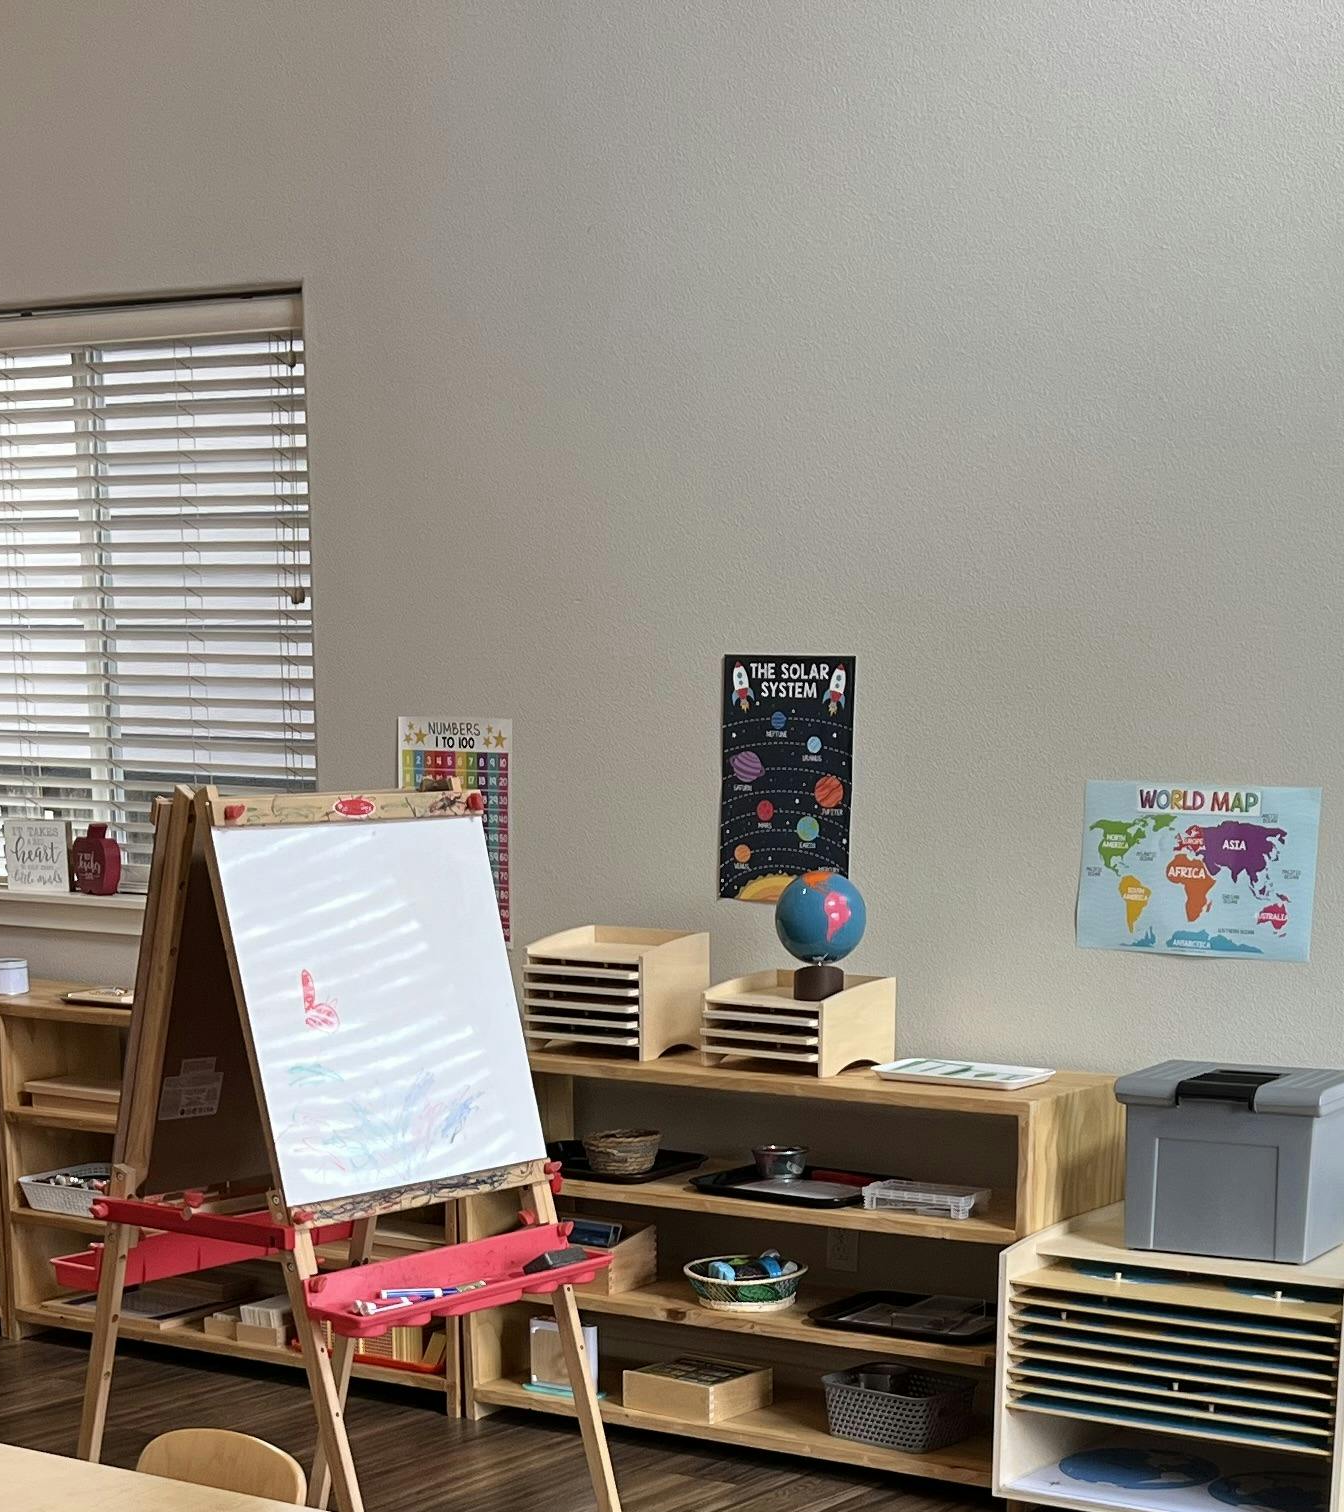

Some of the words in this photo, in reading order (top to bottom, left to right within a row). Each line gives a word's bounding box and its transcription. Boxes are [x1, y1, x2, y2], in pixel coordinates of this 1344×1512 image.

[750, 663, 776, 679] THE
[781, 663, 830, 680] SOLAR
[761, 681, 817, 698] SYSTEM
[428, 721, 481, 737] NUMBERS
[435, 735, 439, 748] 1
[442, 736, 455, 749] TO
[458, 736, 475, 749] 100
[489, 757, 495, 767] 9
[499, 757, 508, 768] 10
[1139, 789, 1205, 810] WORLD
[1210, 791, 1259, 813] MAP
[27, 827, 59, 837] TAKES
[9, 836, 63, 864] heart
[1222, 840, 1247, 851] ASIA
[1167, 866, 1206, 879] AFRICA
